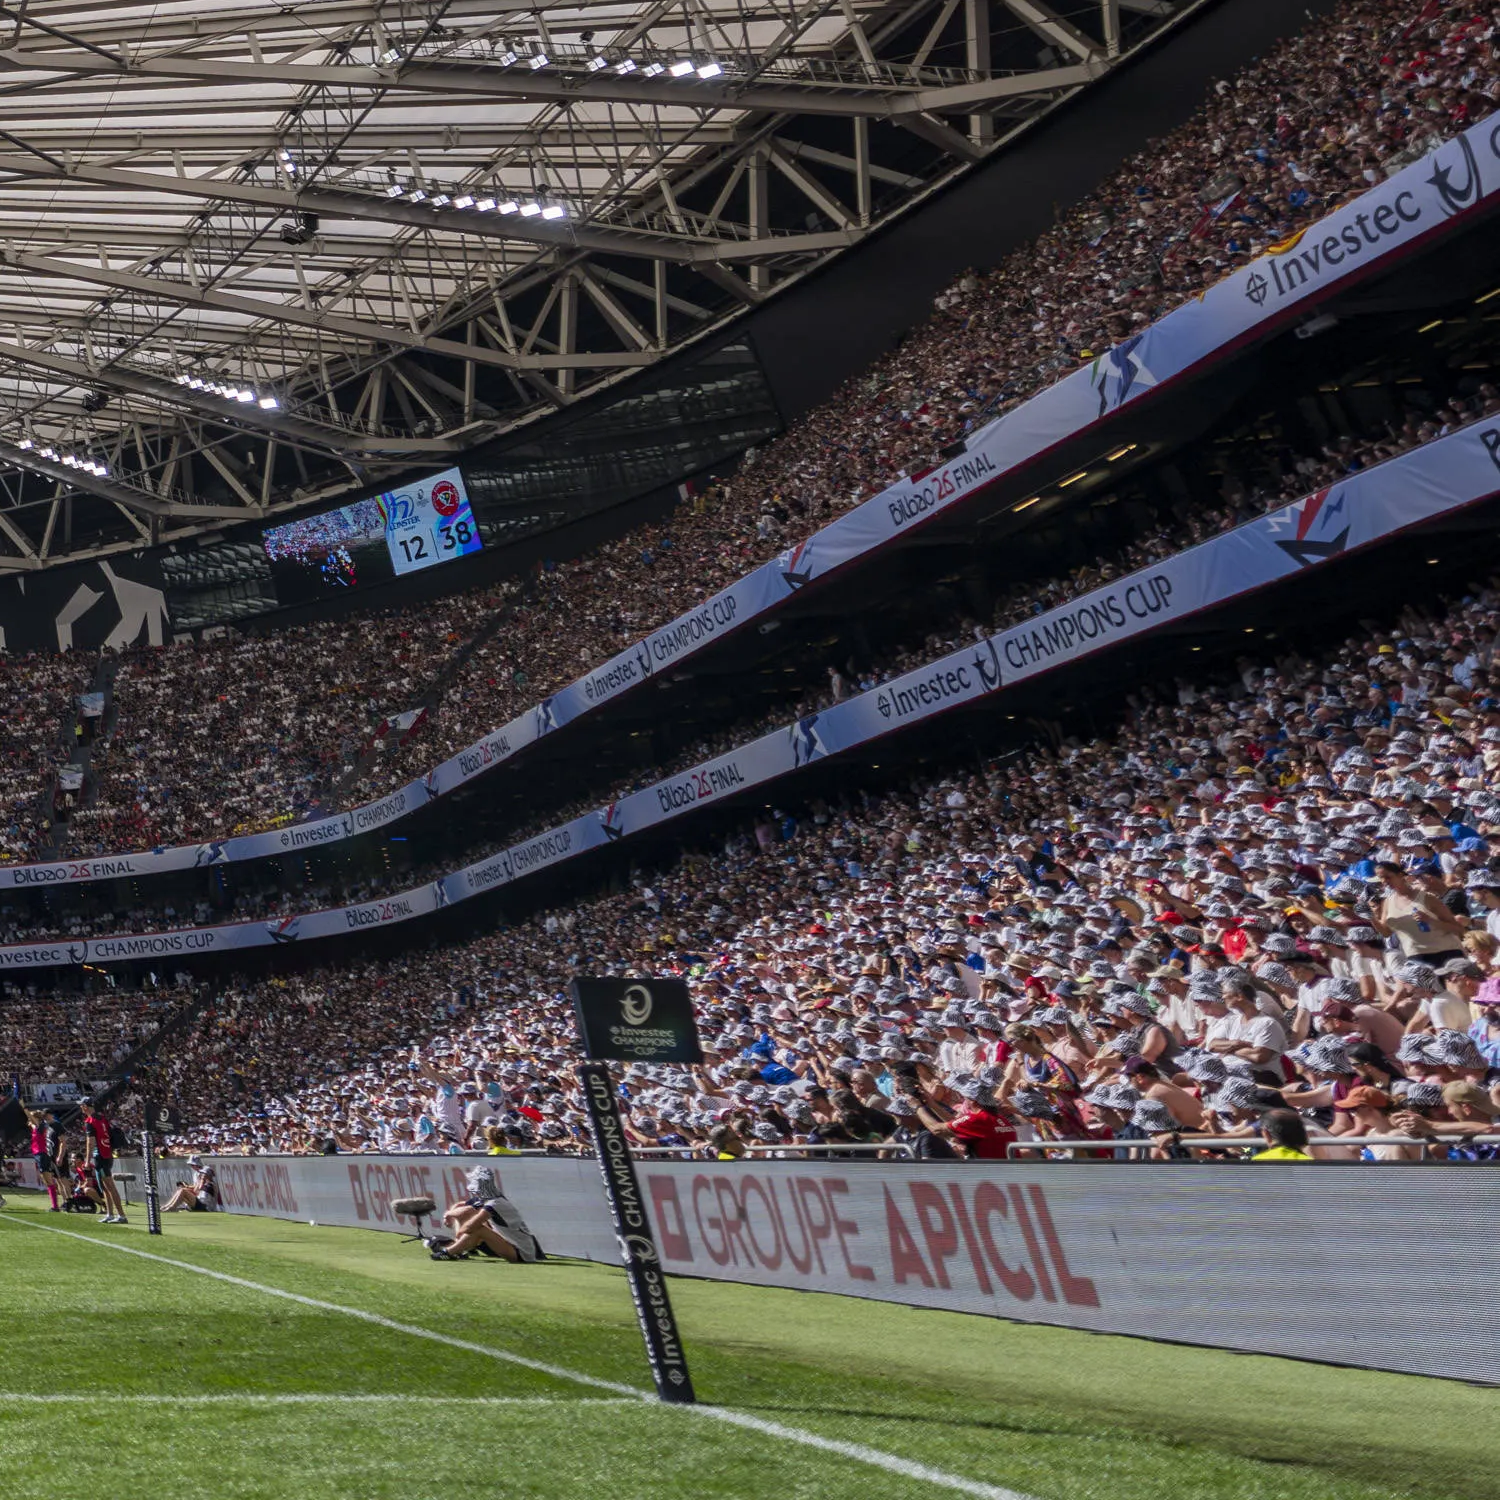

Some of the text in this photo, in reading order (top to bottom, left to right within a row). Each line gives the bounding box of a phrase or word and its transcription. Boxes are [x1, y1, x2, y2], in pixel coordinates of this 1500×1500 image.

[1267, 190, 1422, 297] Investec
[888, 452, 996, 527] Bilbao 26 FINAL
[400, 521, 472, 563] 12 38
[592, 594, 738, 697] Investec CHAMPIONS CUP
[889, 575, 1173, 718] Investec CHAMPIONS CUP
[458, 734, 511, 776] Bilbao 26 FINAL
[657, 762, 745, 813] Bilbao 26 FINAL
[290, 794, 406, 846] Investec CHAMPIONS CUP
[514, 836, 556, 868] CHAMPIONS
[553, 830, 571, 856] CUP
[13, 861, 135, 885] Bilbao 26 FINAL
[345, 900, 413, 928] Bilbao 26 FINAL
[95, 934, 183, 957] CHAMPIONS
[185, 932, 215, 948] CUP
[611, 1037, 677, 1047] CHAMPIONS
[621, 1026, 675, 1038] Investec
[633, 1047, 656, 1056] CUP
[589, 1073, 612, 1111] CUP
[600, 1115, 643, 1228] CHAMPIONS
[692, 1173, 1100, 1308] GROUPE APICIL
[644, 1270, 682, 1366] Investec
